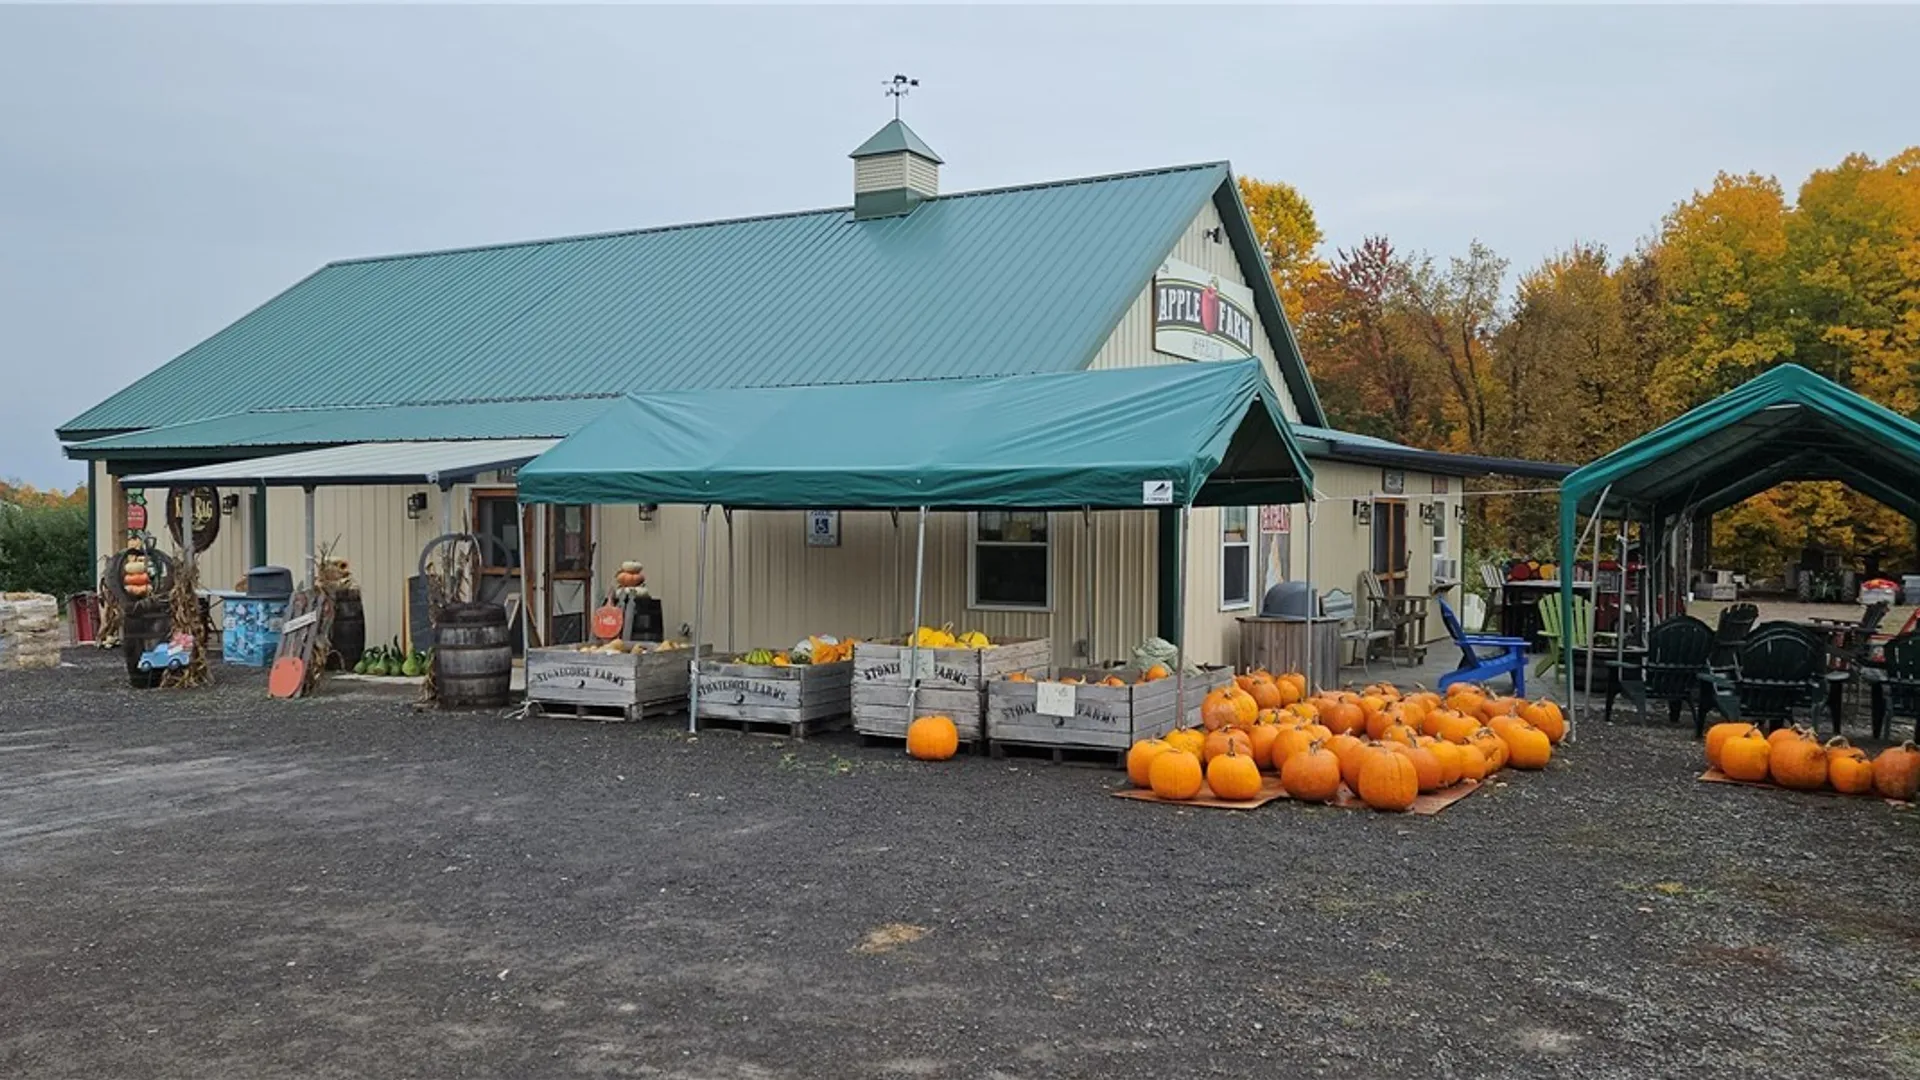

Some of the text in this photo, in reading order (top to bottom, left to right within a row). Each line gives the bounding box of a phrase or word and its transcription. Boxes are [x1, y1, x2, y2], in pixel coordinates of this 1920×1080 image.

[1158, 288, 1200, 322] APPLE
[1218, 301, 1251, 350] FARM
[864, 662, 900, 680] STONE
